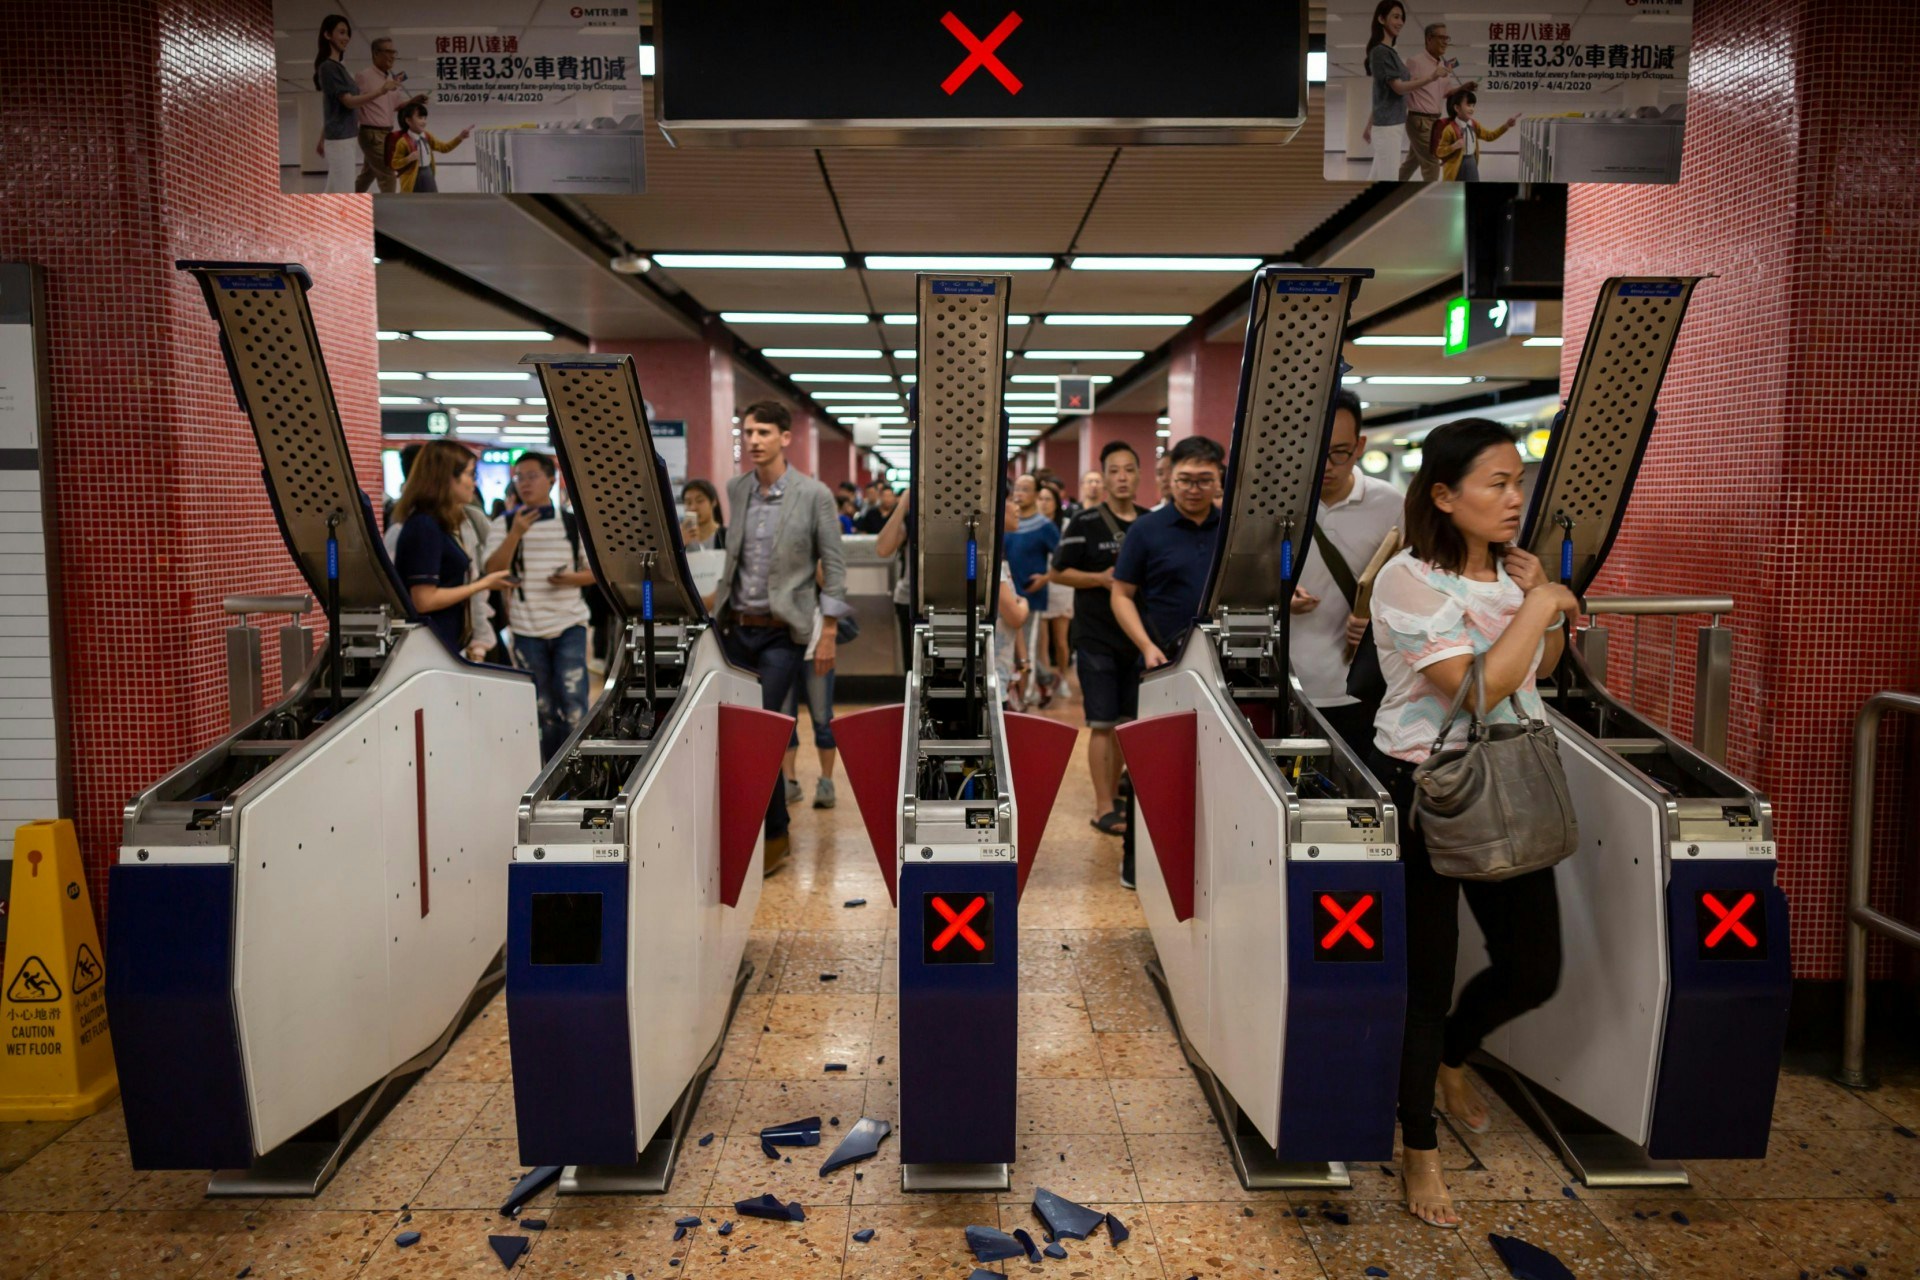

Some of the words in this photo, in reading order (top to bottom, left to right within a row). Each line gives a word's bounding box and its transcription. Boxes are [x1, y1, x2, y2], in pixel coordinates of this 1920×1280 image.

[584, 8, 609, 17] MTR
[1489, 23, 1571, 41] 使用八達通
[436, 36, 518, 54] 使用八達通
[1488, 43, 1674, 69] 程程3.3%車費扣減
[437, 56, 626, 81] 程程3.3%車費扣減
[1508, 70, 1534, 78] rebate
[1535, 70, 1546, 78] for
[1547, 71, 1568, 80] every
[1570, 70, 1614, 80] fare-paying
[1616, 71, 1629, 80] trip
[1631, 71, 1641, 80] by
[1642, 71, 1674, 80] Octopus
[458, 82, 483, 91] rebate
[484, 82, 495, 91] for
[497, 83, 519, 93] every
[520, 82, 566, 93] fare-paying
[567, 82, 580, 93] trip
[582, 82, 592, 93] by
[593, 82, 627, 93] Octopus
[1487, 80, 1538, 91] 30/6/2019
[1547, 80, 1592, 91] 4/4/2020
[437, 93, 488, 103] 30/6/2019
[498, 92, 543, 103] 4/4/2020
[607, 849, 619, 858] 5B
[994, 848, 1006, 857] 5C
[1381, 848, 1393, 857] 5D
[1760, 846, 1772, 855] 5E
[6, 1008, 61, 1020] 小心地滑
[12, 1026, 55, 1039] CAUTION
[7, 1043, 28, 1056] WET
[30, 1042, 62, 1056] FLOOR
